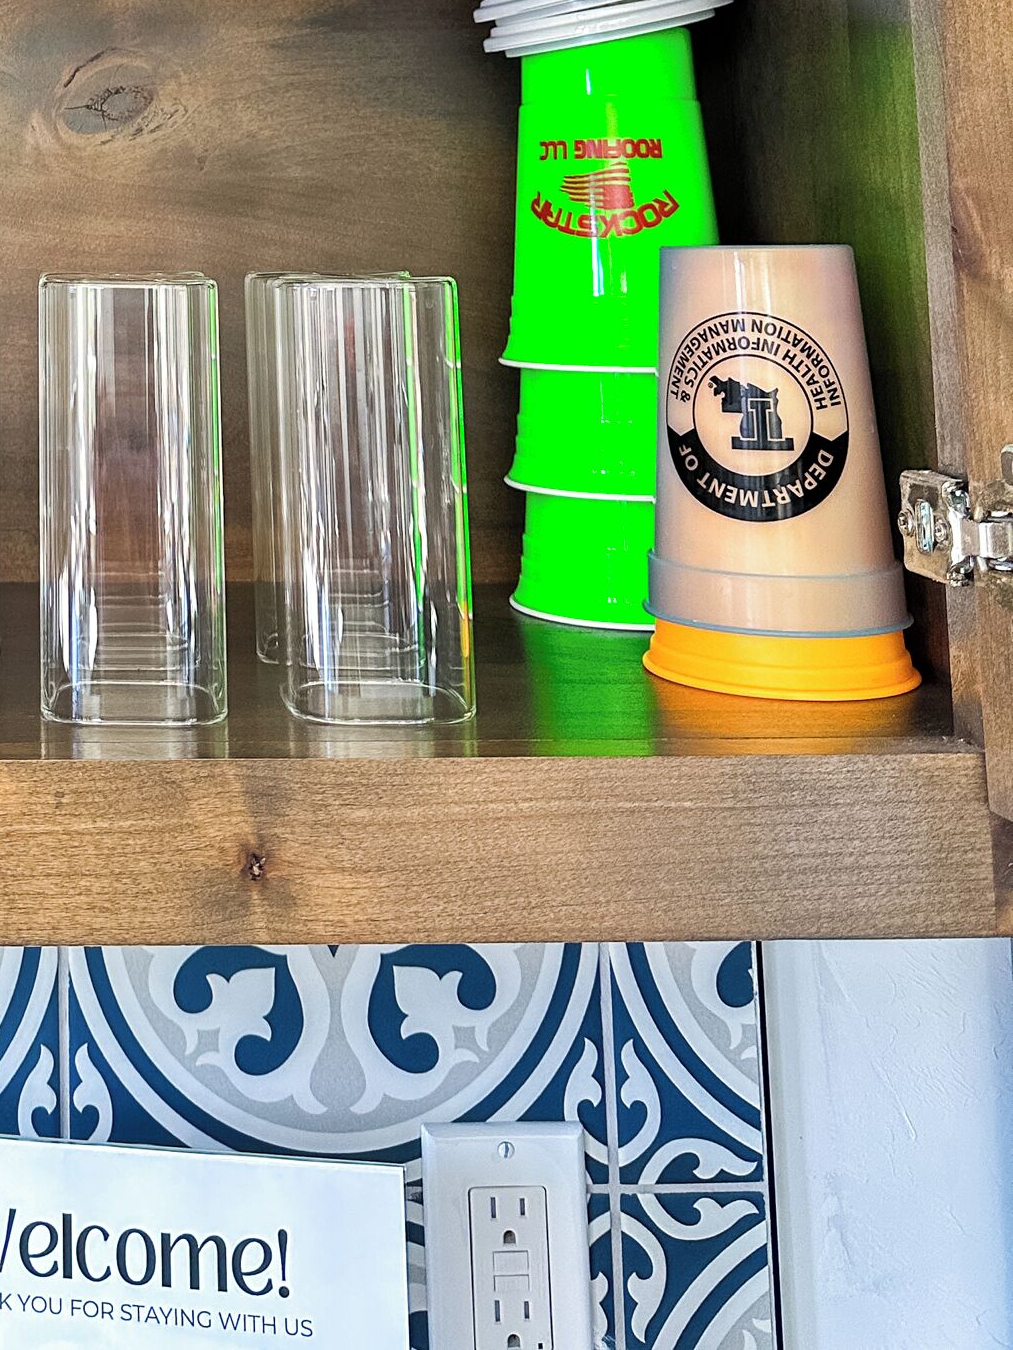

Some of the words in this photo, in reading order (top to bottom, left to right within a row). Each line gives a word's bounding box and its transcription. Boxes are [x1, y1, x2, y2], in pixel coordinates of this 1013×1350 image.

[539, 140, 568, 161] LLC
[574, 138, 663, 160] ROOFING
[530, 189, 680, 238] ROCKSTAR
[669, 318, 746, 397] MANAGEMENT
[683, 336, 780, 388] INFORMATICS
[750, 318, 841, 407] INFORMATION
[781, 349, 829, 411] HEALTH
[679, 389, 691, 403] &
[678, 443, 699, 471] OF
[696, 449, 834, 507] DEPARTMENT
[17, 1292, 65, 1317] YOU
[71, 1299, 114, 1321] FOR
[120, 1303, 213, 1330] STAYING
[218, 1312, 277, 1336] WITH
[284, 1318, 314, 1338] US
